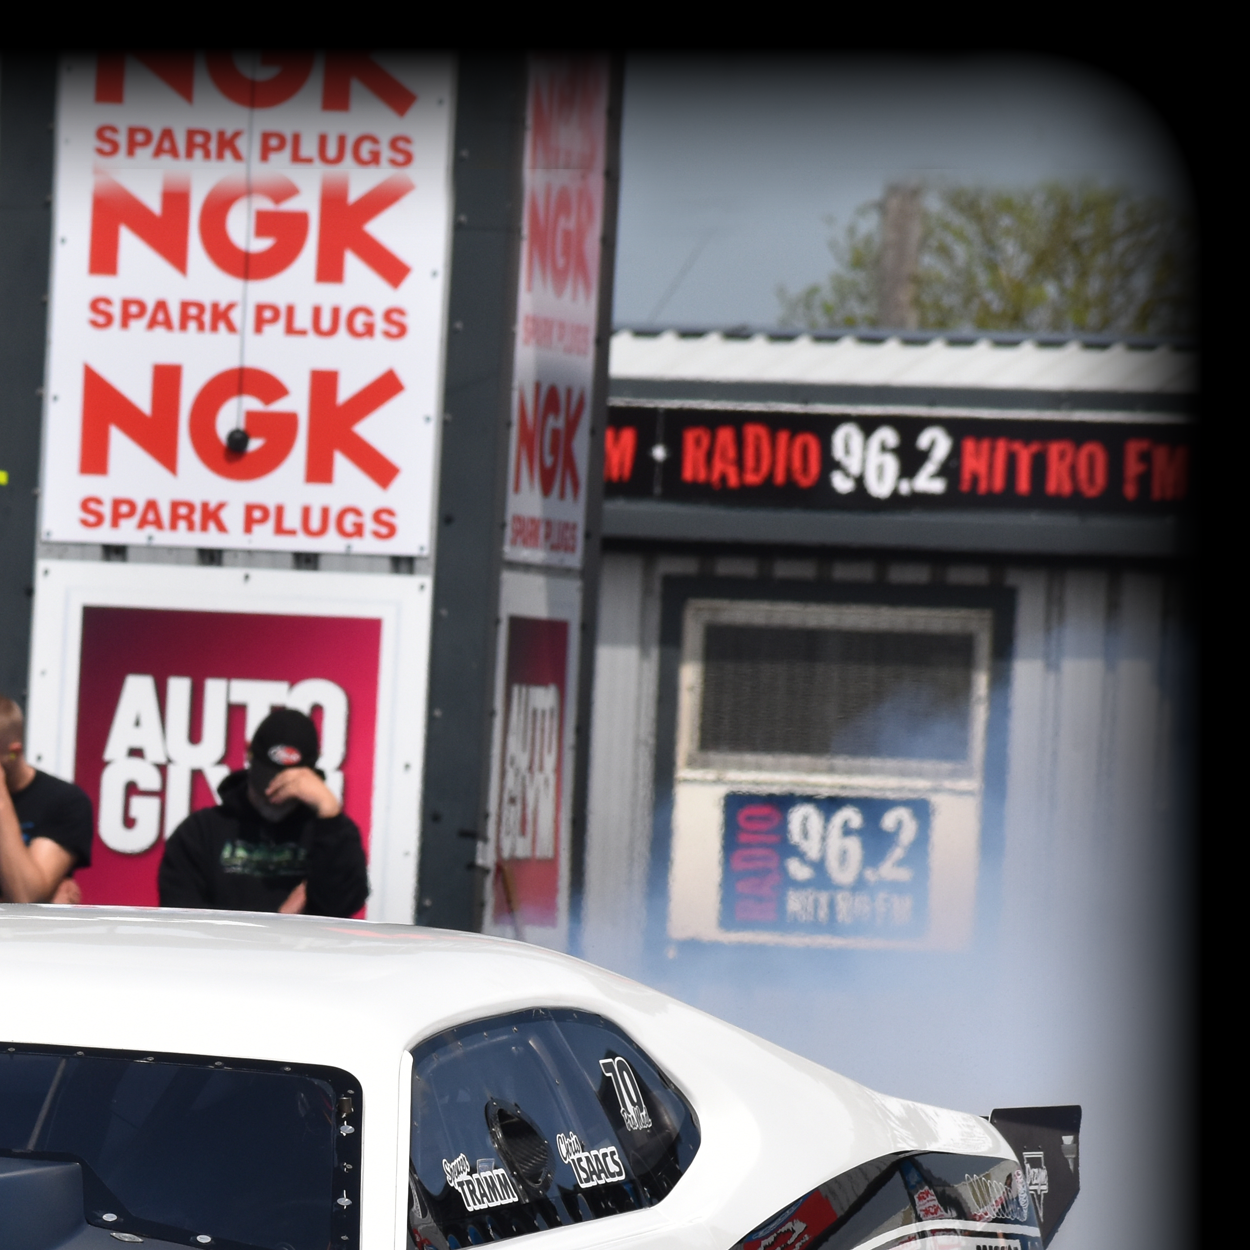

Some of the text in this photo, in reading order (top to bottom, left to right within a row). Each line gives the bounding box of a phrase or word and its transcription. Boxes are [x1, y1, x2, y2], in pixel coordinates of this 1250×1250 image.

[94, 125, 415, 168] SPARK PLUGS
[88, 171, 417, 290] NGK
[88, 297, 409, 340] SPARK PLUGS
[79, 362, 406, 491] NGK
[514, 381, 586, 503] NGK
[680, 421, 1190, 501] RADIO 96.2 NITRO FM
[79, 497, 398, 540] SPARK PLUGS
[103, 673, 350, 768] AUTO
[730, 803, 784, 922] RADIO
[784, 803, 918, 887] 96.2
[599, 1056, 646, 1115] 70
[453, 1169, 518, 1211] TRAMM
[570, 1146, 626, 1188] ISAACS
